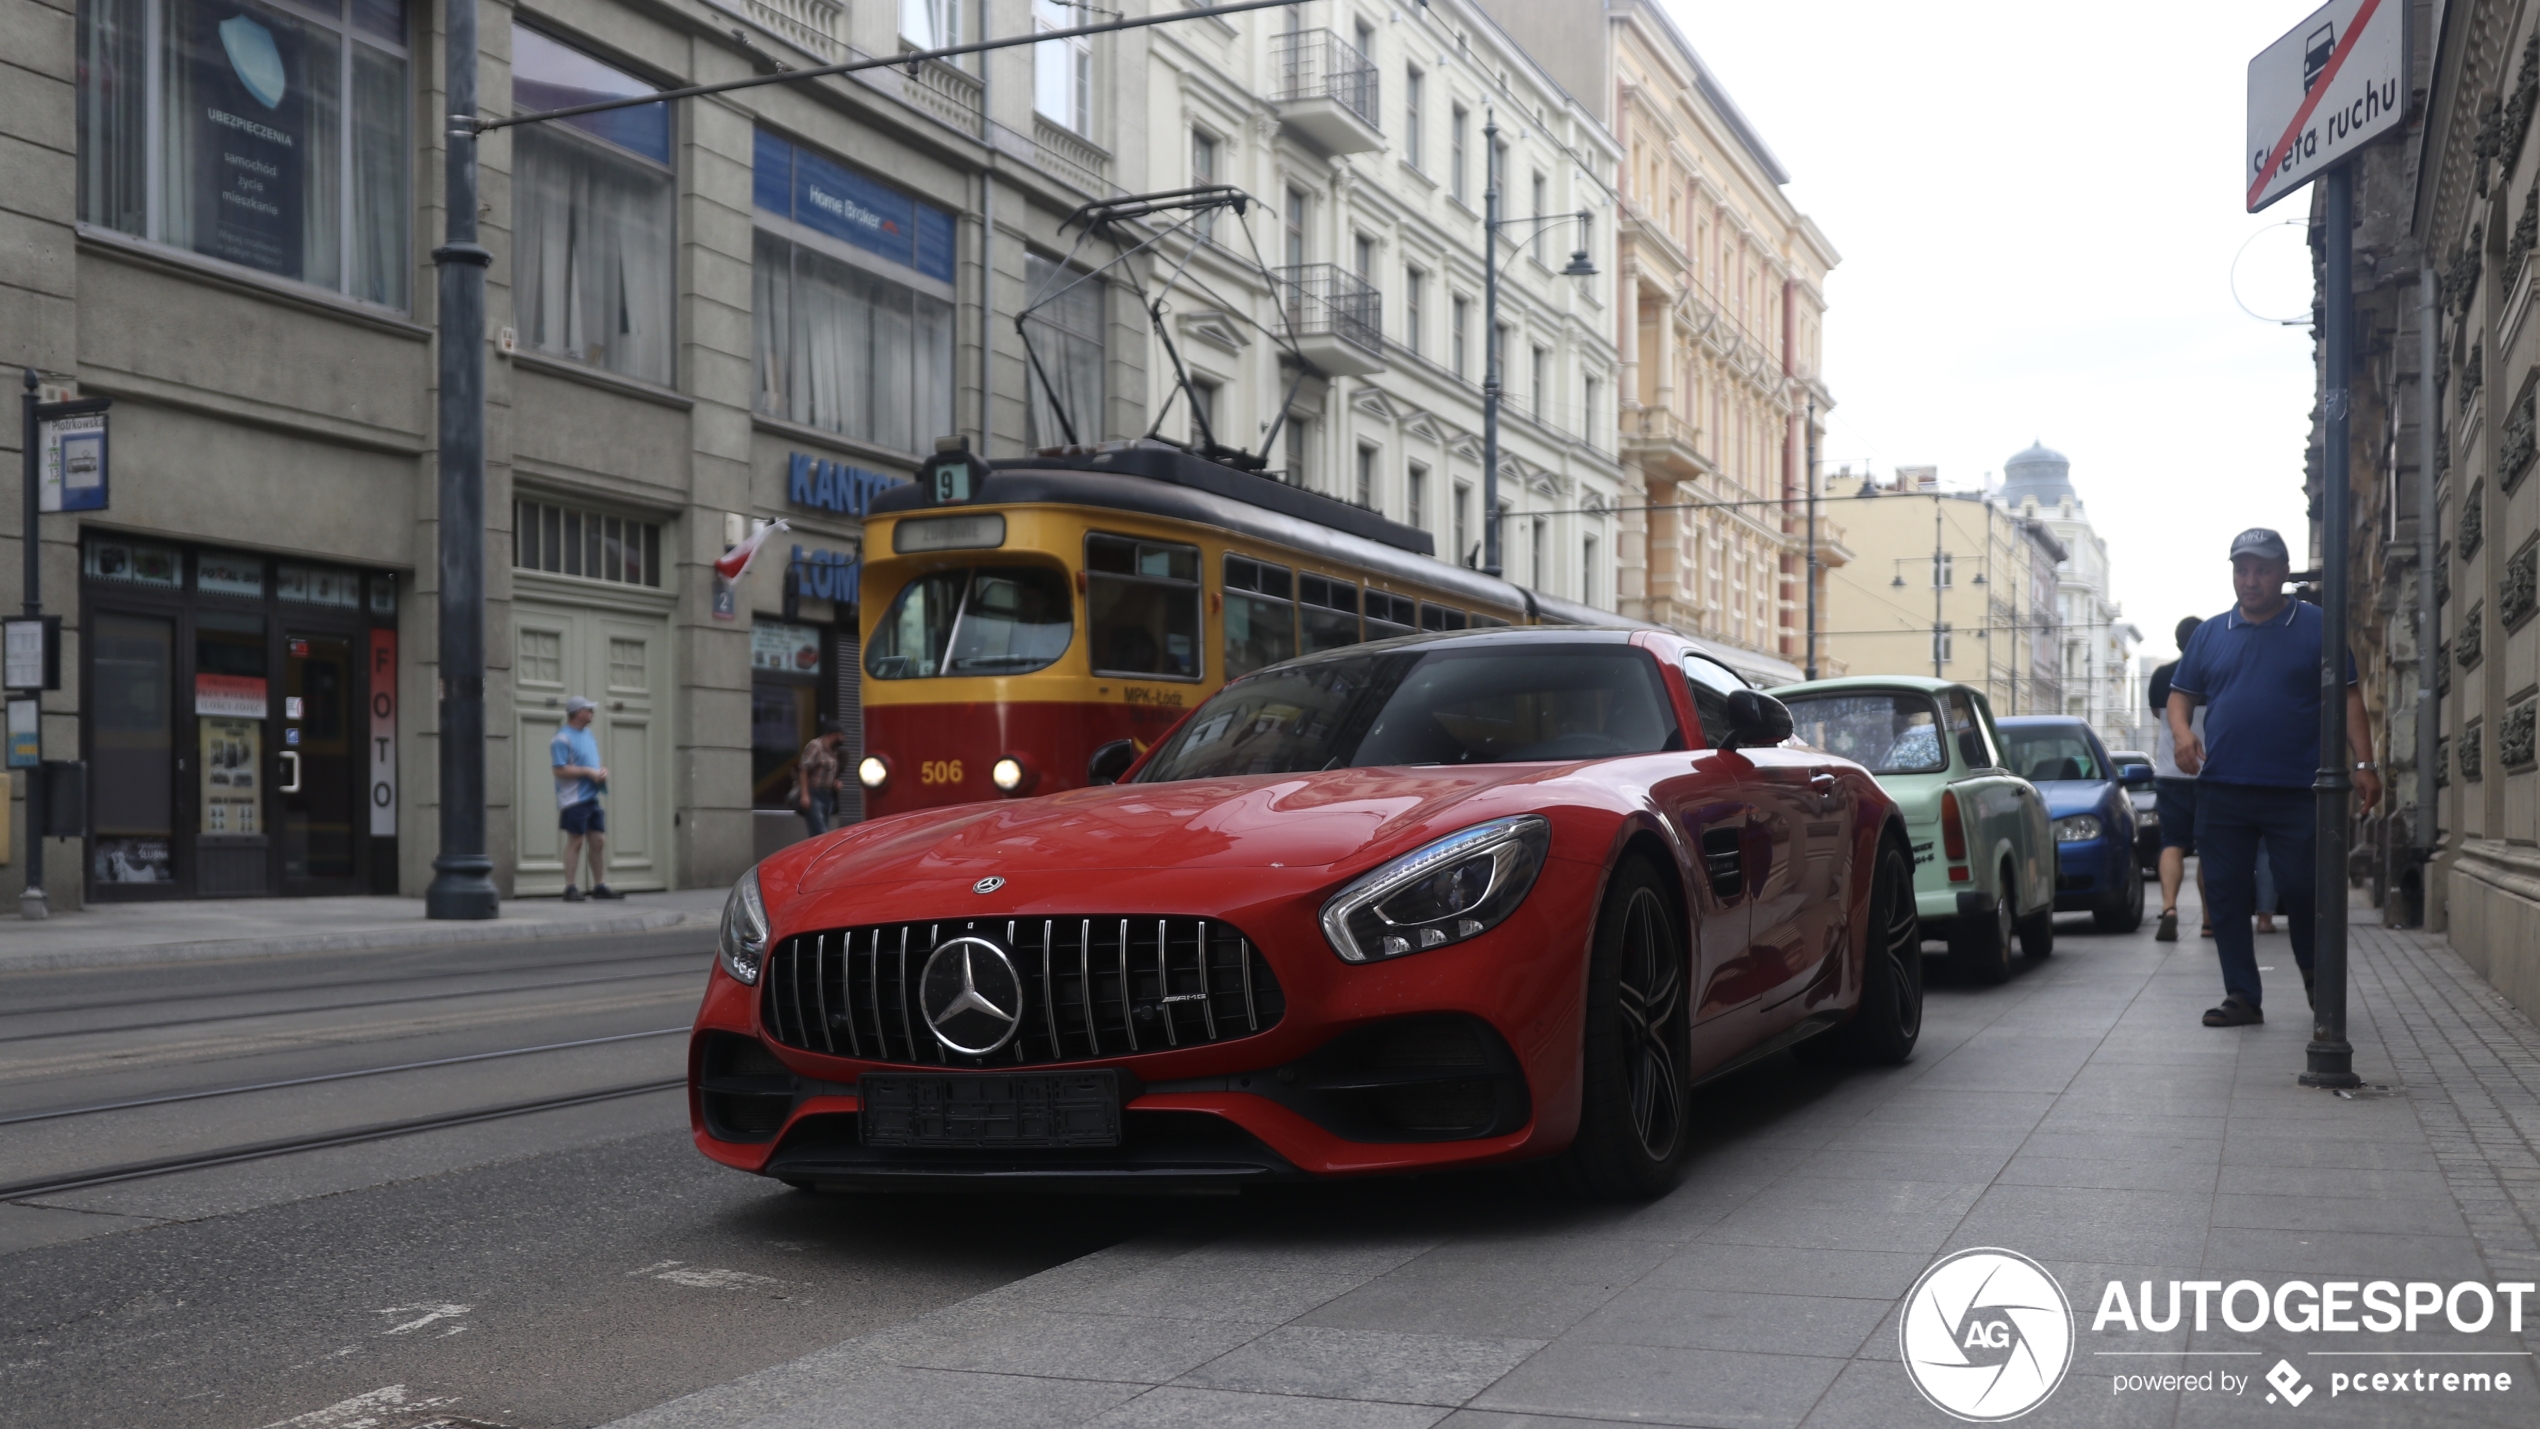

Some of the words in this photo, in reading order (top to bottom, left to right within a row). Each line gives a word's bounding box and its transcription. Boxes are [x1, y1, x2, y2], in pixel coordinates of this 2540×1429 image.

[2328, 78, 2395, 145] ruchu
[207, 107, 293, 147] UBEZPIECZENIA
[224, 152, 277, 177] samochód
[237, 173, 264, 192] życie
[222, 190, 279, 215] mieszkanie
[810, 184, 843, 214] Home
[844, 199, 880, 230] Broker
[51, 417, 104, 431] Piotrkowska
[51, 436, 57, 446] 9
[49, 452, 59, 462] 12
[49, 468, 59, 478] 13
[789, 451, 907, 517] KANTO
[940, 470, 954, 499] 9
[719, 592, 729, 611] 2
[373, 647, 391, 807] FOTO
[921, 759, 963, 784] 506
[1177, 993, 1206, 1001] AMG
